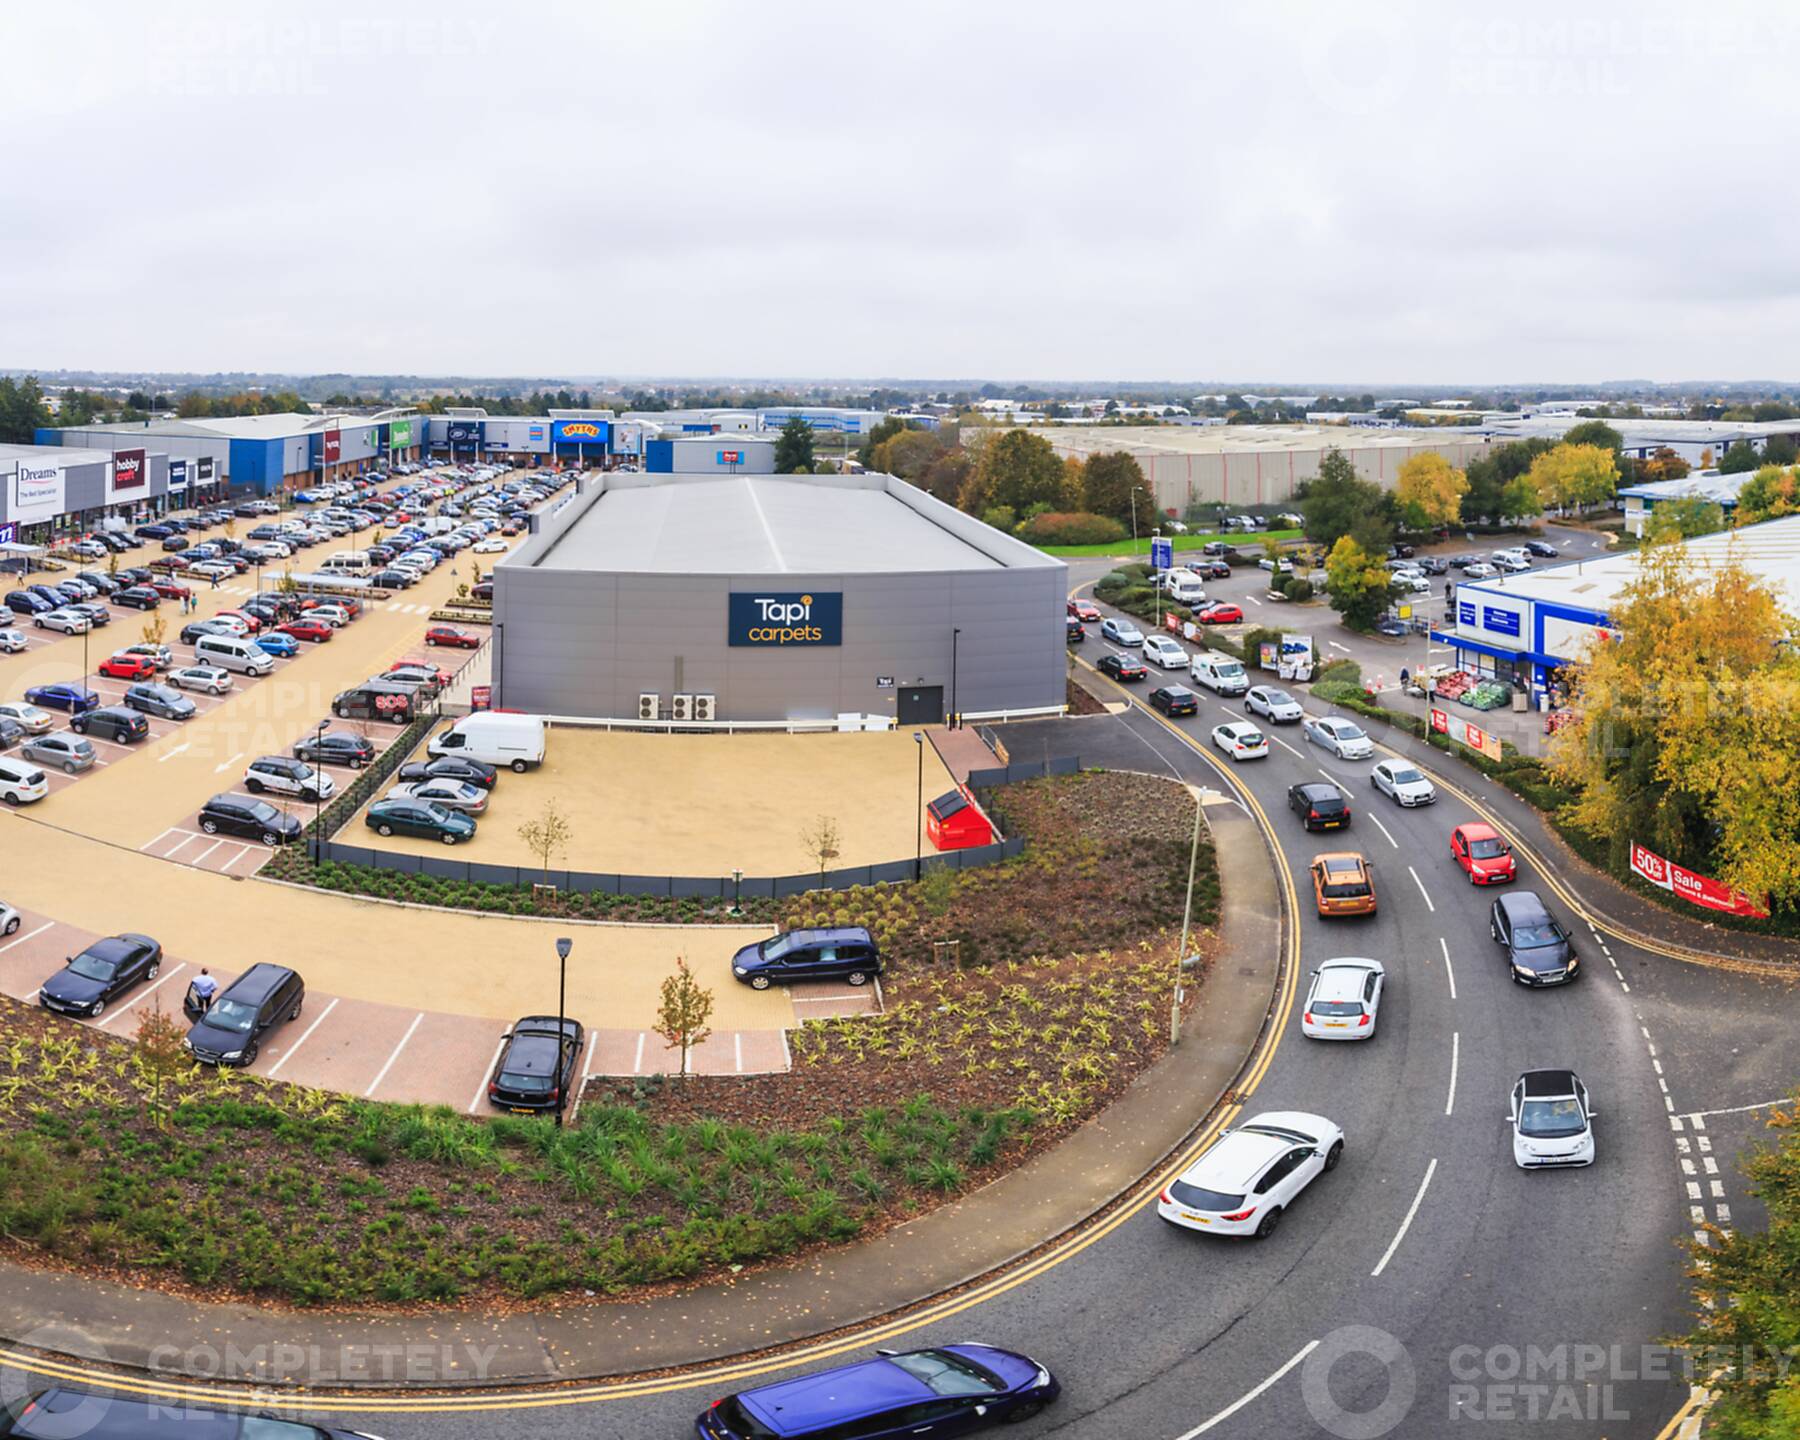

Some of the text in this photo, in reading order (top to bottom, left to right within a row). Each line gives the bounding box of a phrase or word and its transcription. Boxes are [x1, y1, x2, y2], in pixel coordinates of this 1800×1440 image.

[562, 423, 600, 437] SMYTHS
[117, 459, 139, 471] hobby
[20, 468, 57, 481] Dreams
[117, 470, 134, 481] craft
[754, 594, 813, 626] Tapi
[748, 625, 822, 644] carpets
[375, 695, 408, 709] SOS
[1636, 848, 1663, 875] 50%
[1674, 870, 1702, 890] Sale
